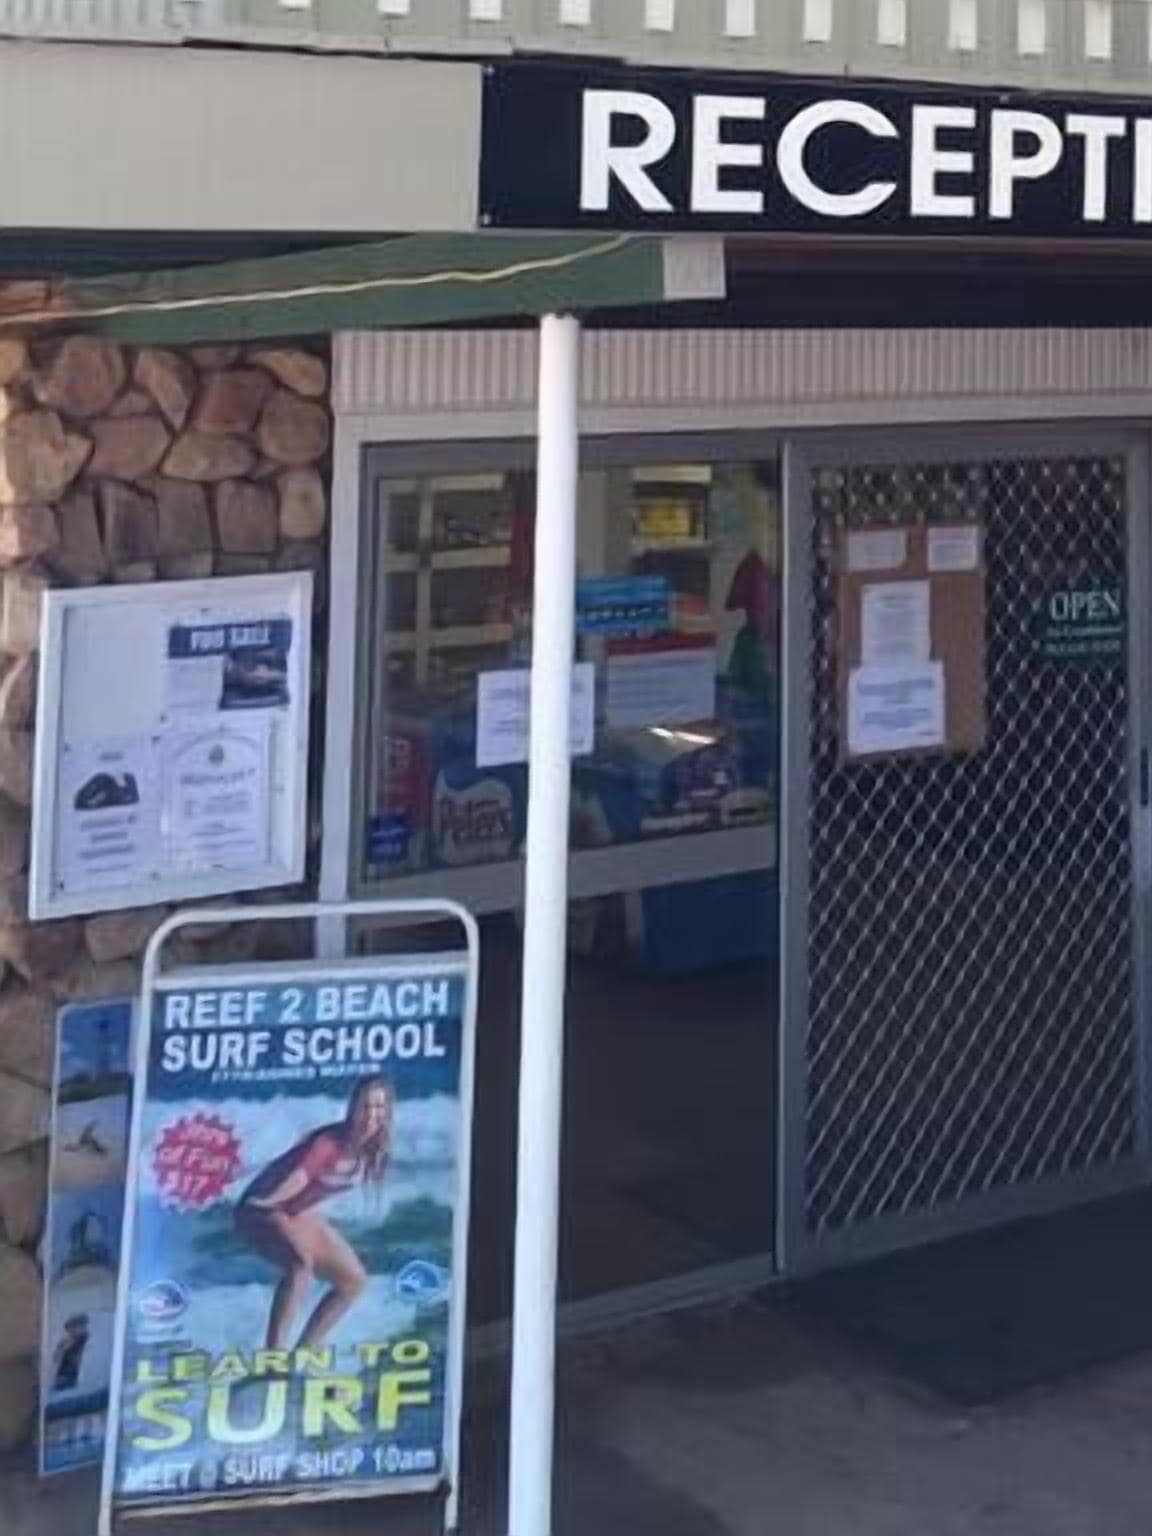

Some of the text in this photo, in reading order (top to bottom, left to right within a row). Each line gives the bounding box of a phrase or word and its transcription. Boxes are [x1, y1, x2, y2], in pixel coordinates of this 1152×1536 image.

[1051, 591, 1119, 620] OPEN
[165, 981, 449, 1028] REEF 2 BEACH
[162, 1023, 445, 1072] SURF SCHOOL
[136, 1340, 429, 1382] LEARN TO
[132, 1368, 430, 1451] SURF
[295, 1447, 364, 1477] SHOP
[374, 1447, 437, 1472] 10am
